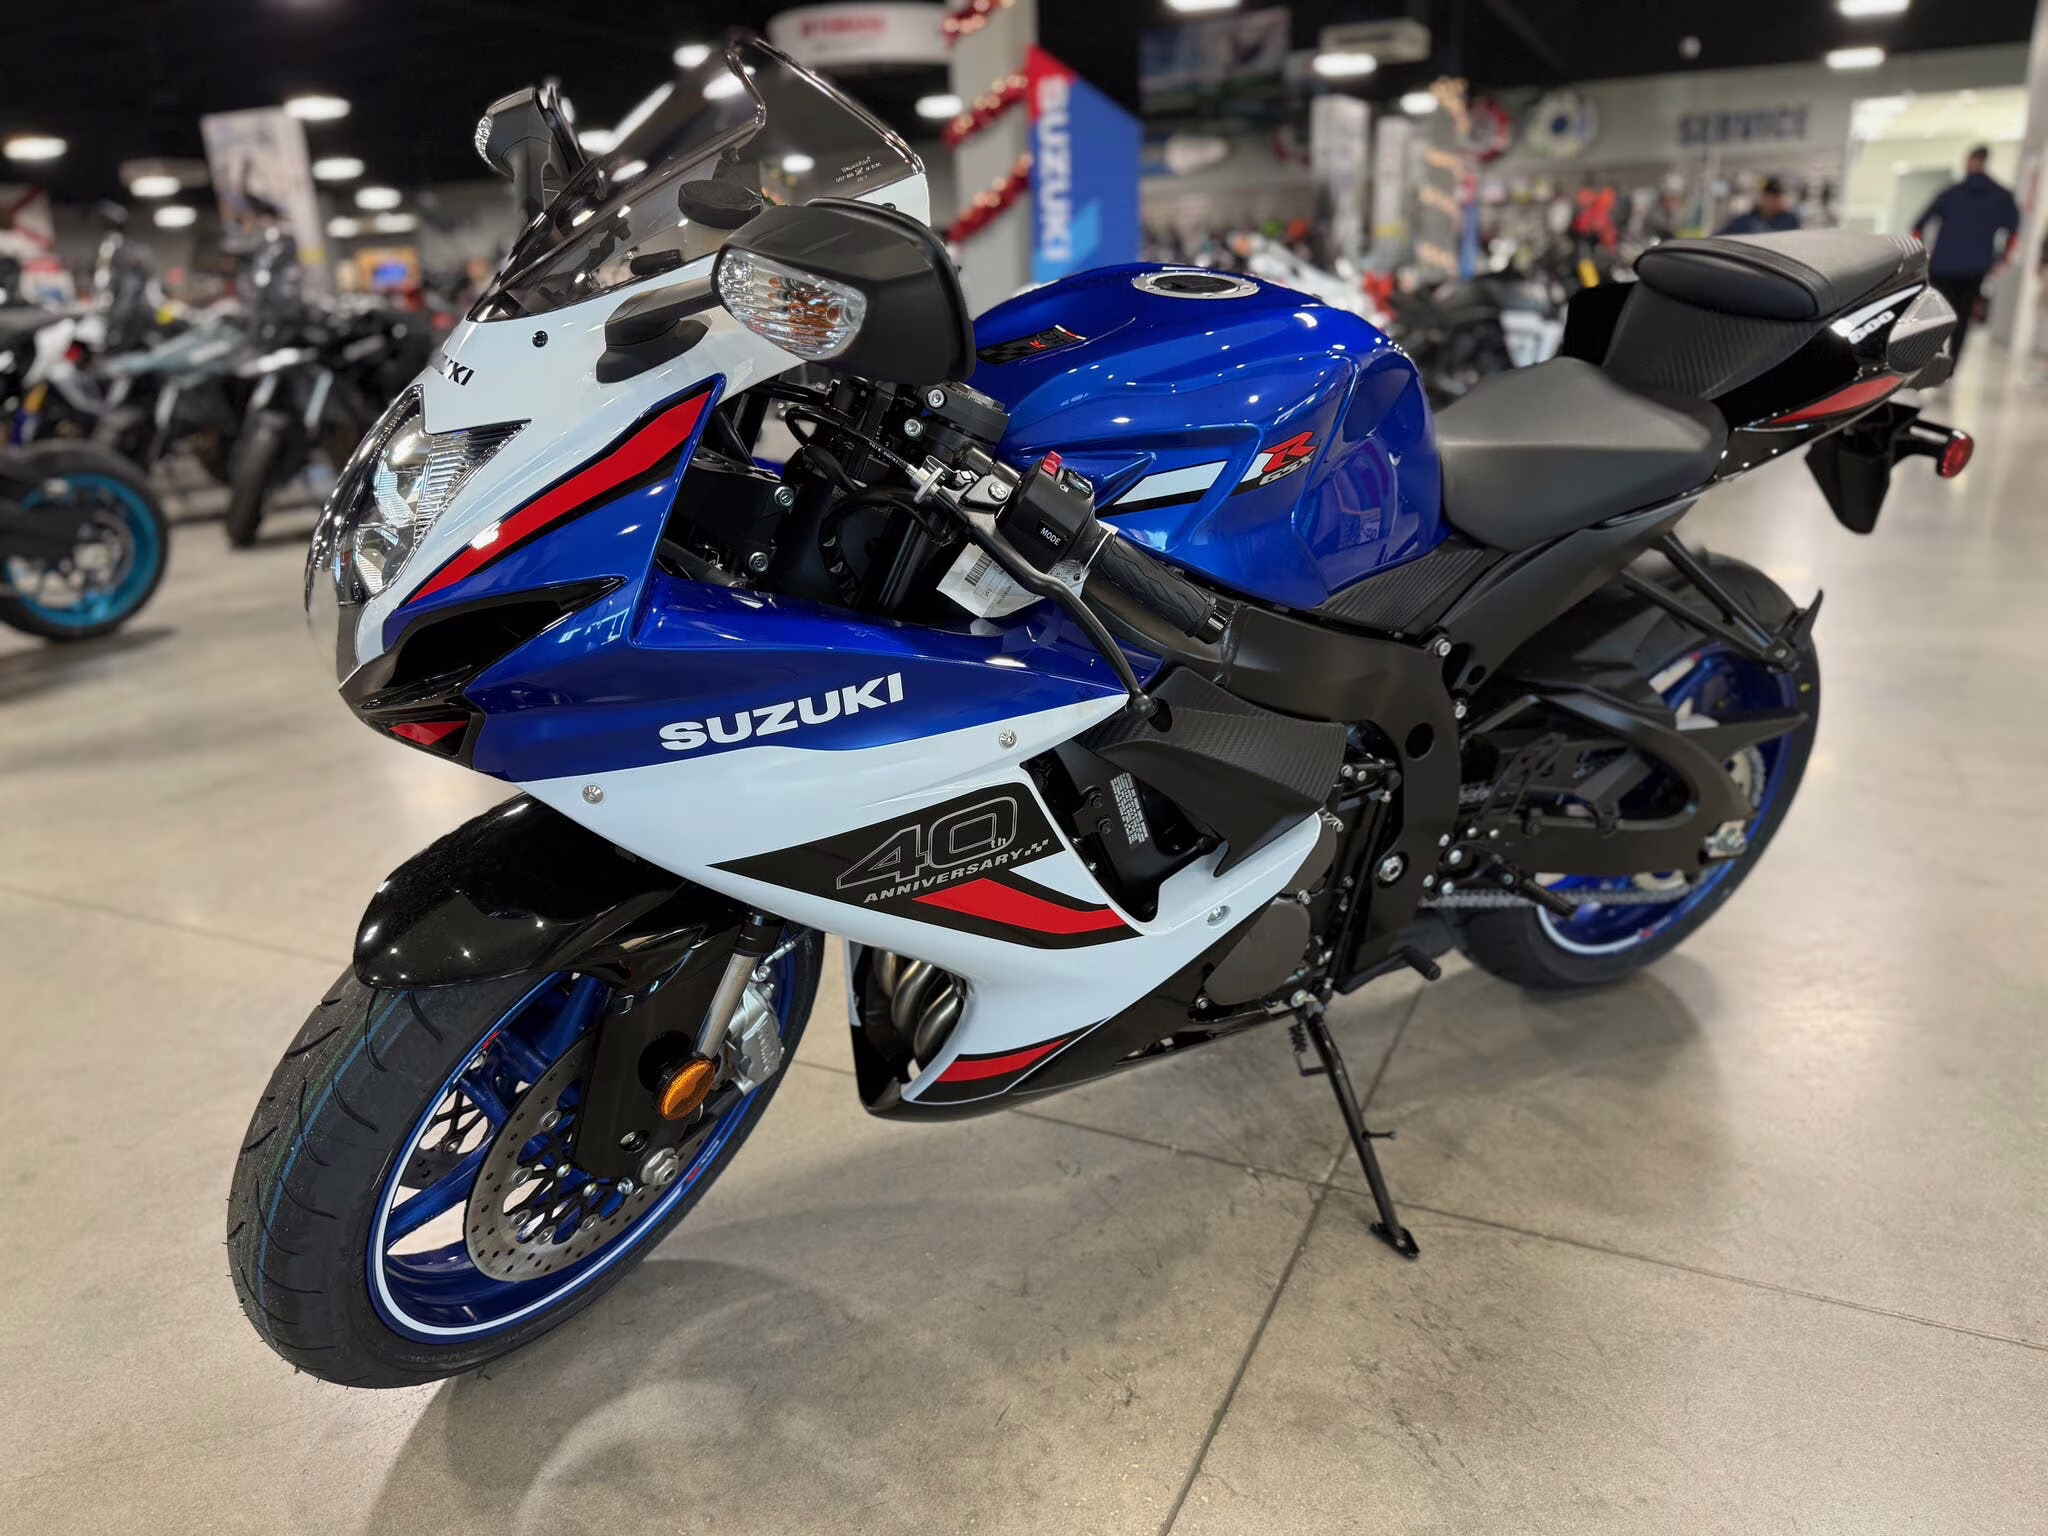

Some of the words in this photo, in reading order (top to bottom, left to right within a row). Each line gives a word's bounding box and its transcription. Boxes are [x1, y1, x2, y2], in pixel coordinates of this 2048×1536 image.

[1678, 105, 1811, 145] SERVICE
[1037, 75, 1073, 262] SUZUKI
[1847, 309, 1896, 345] 600
[1040, 527, 1062, 547] MODE
[658, 671, 904, 751] SUZUKI
[863, 847, 1024, 904] ANNIVERSARY
